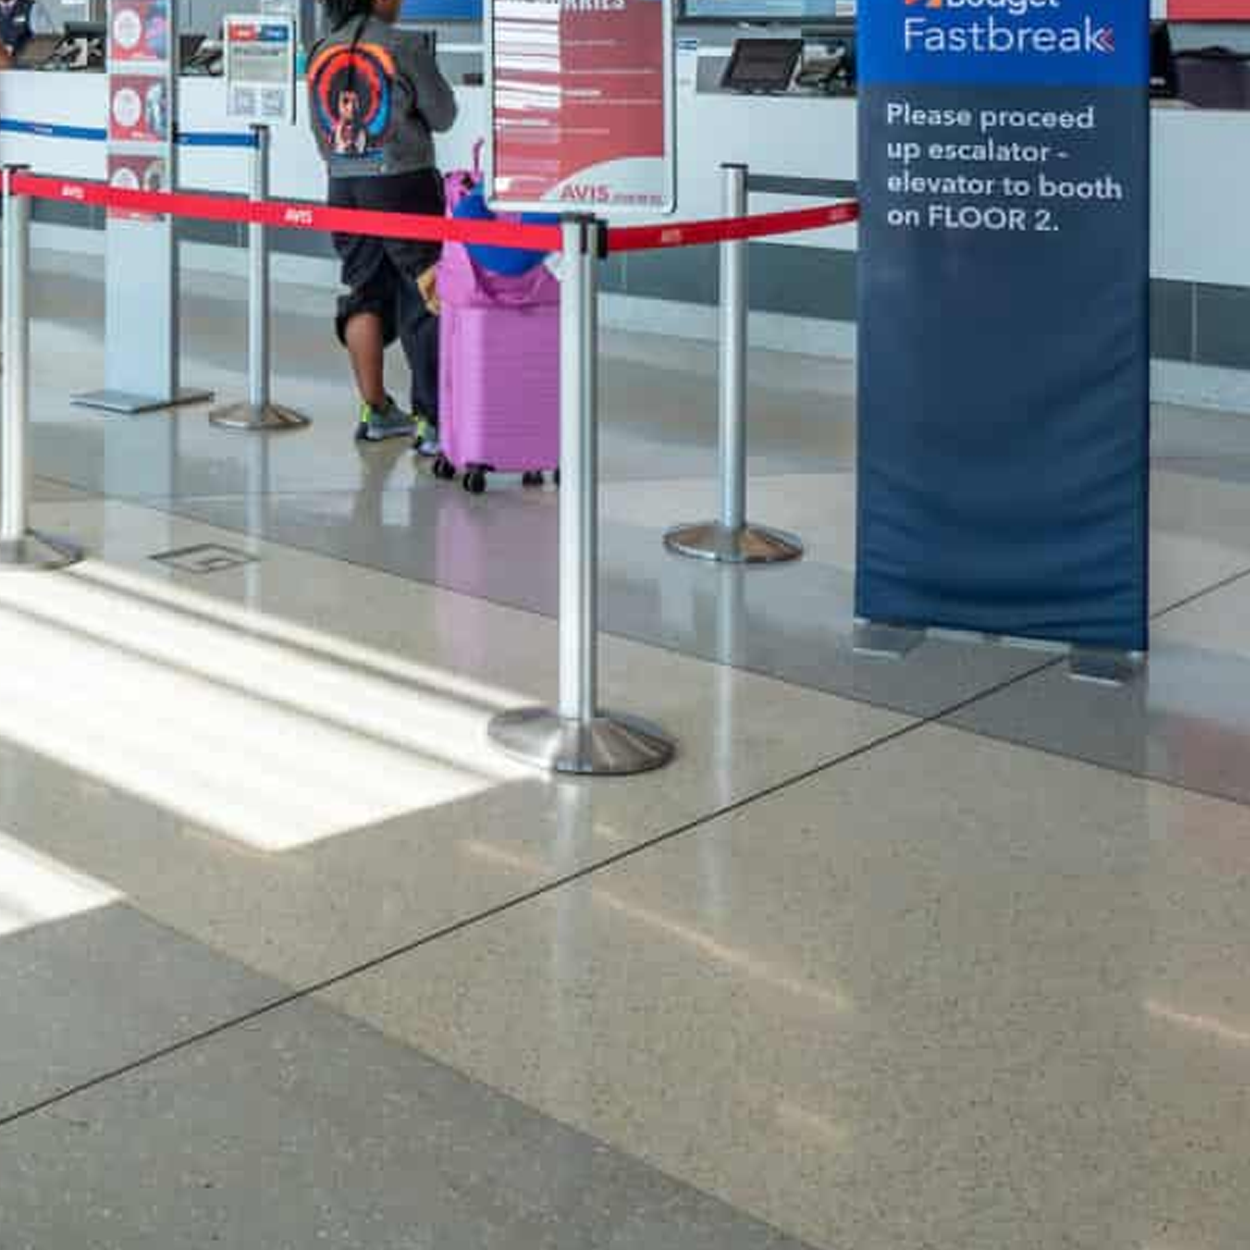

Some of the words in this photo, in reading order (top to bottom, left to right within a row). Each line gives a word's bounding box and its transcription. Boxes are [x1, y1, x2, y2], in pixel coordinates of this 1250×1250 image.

[904, 15, 1108, 52] Fastbreak
[887, 102, 972, 126] Please
[980, 105, 1095, 134] proceed
[887, 141, 921, 165] up
[928, 137, 1050, 162] escalator
[560, 183, 610, 201] AVIS
[887, 169, 993, 196] elevator
[1003, 176, 1031, 197] to
[1038, 172, 1123, 199] booth
[887, 209, 921, 226] on
[928, 205, 1027, 232] FLOOR
[1035, 209, 1060, 232] 2.
